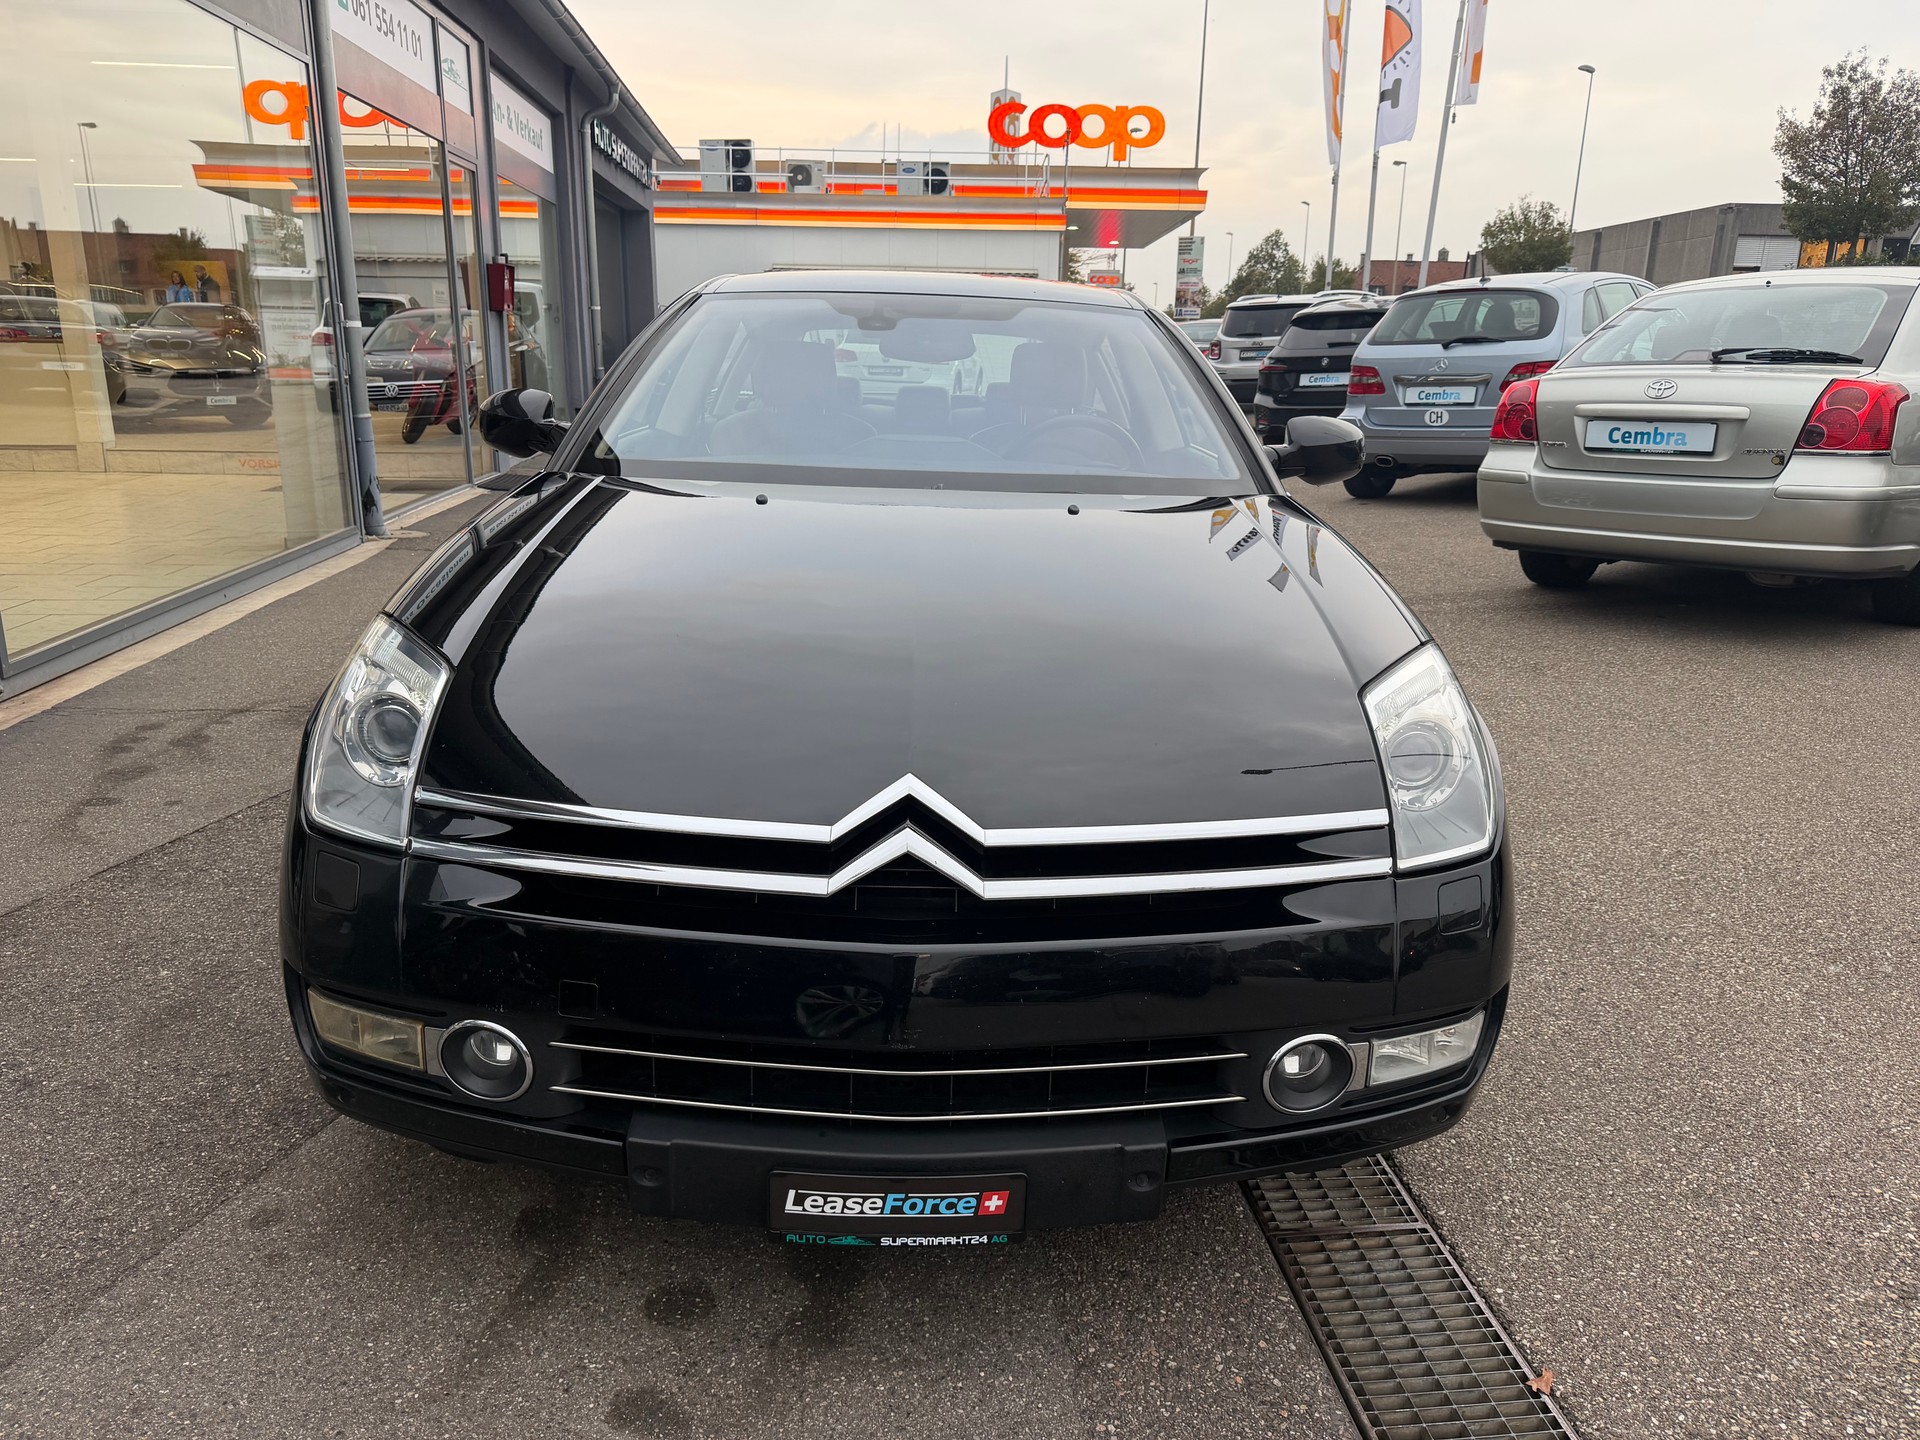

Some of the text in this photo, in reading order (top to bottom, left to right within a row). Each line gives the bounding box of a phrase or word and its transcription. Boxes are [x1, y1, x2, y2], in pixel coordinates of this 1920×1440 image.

[374, 2, 396, 42] 554
[397, 20, 409, 52] 11
[411, 29, 423, 61] 01
[506, 105, 514, 132] &
[513, 110, 544, 151] Verkauf
[988, 101, 1166, 161] coop
[1090, 275, 1121, 287] coop
[1308, 375, 1340, 384] Cembra
[1418, 389, 1461, 401] Cembra
[1429, 411, 1443, 424] CH
[1608, 427, 1687, 446] Cembra
[784, 1189, 977, 1216] LeaseForce
[786, 1234, 826, 1244] AUTO
[991, 1234, 1008, 1244] AG
